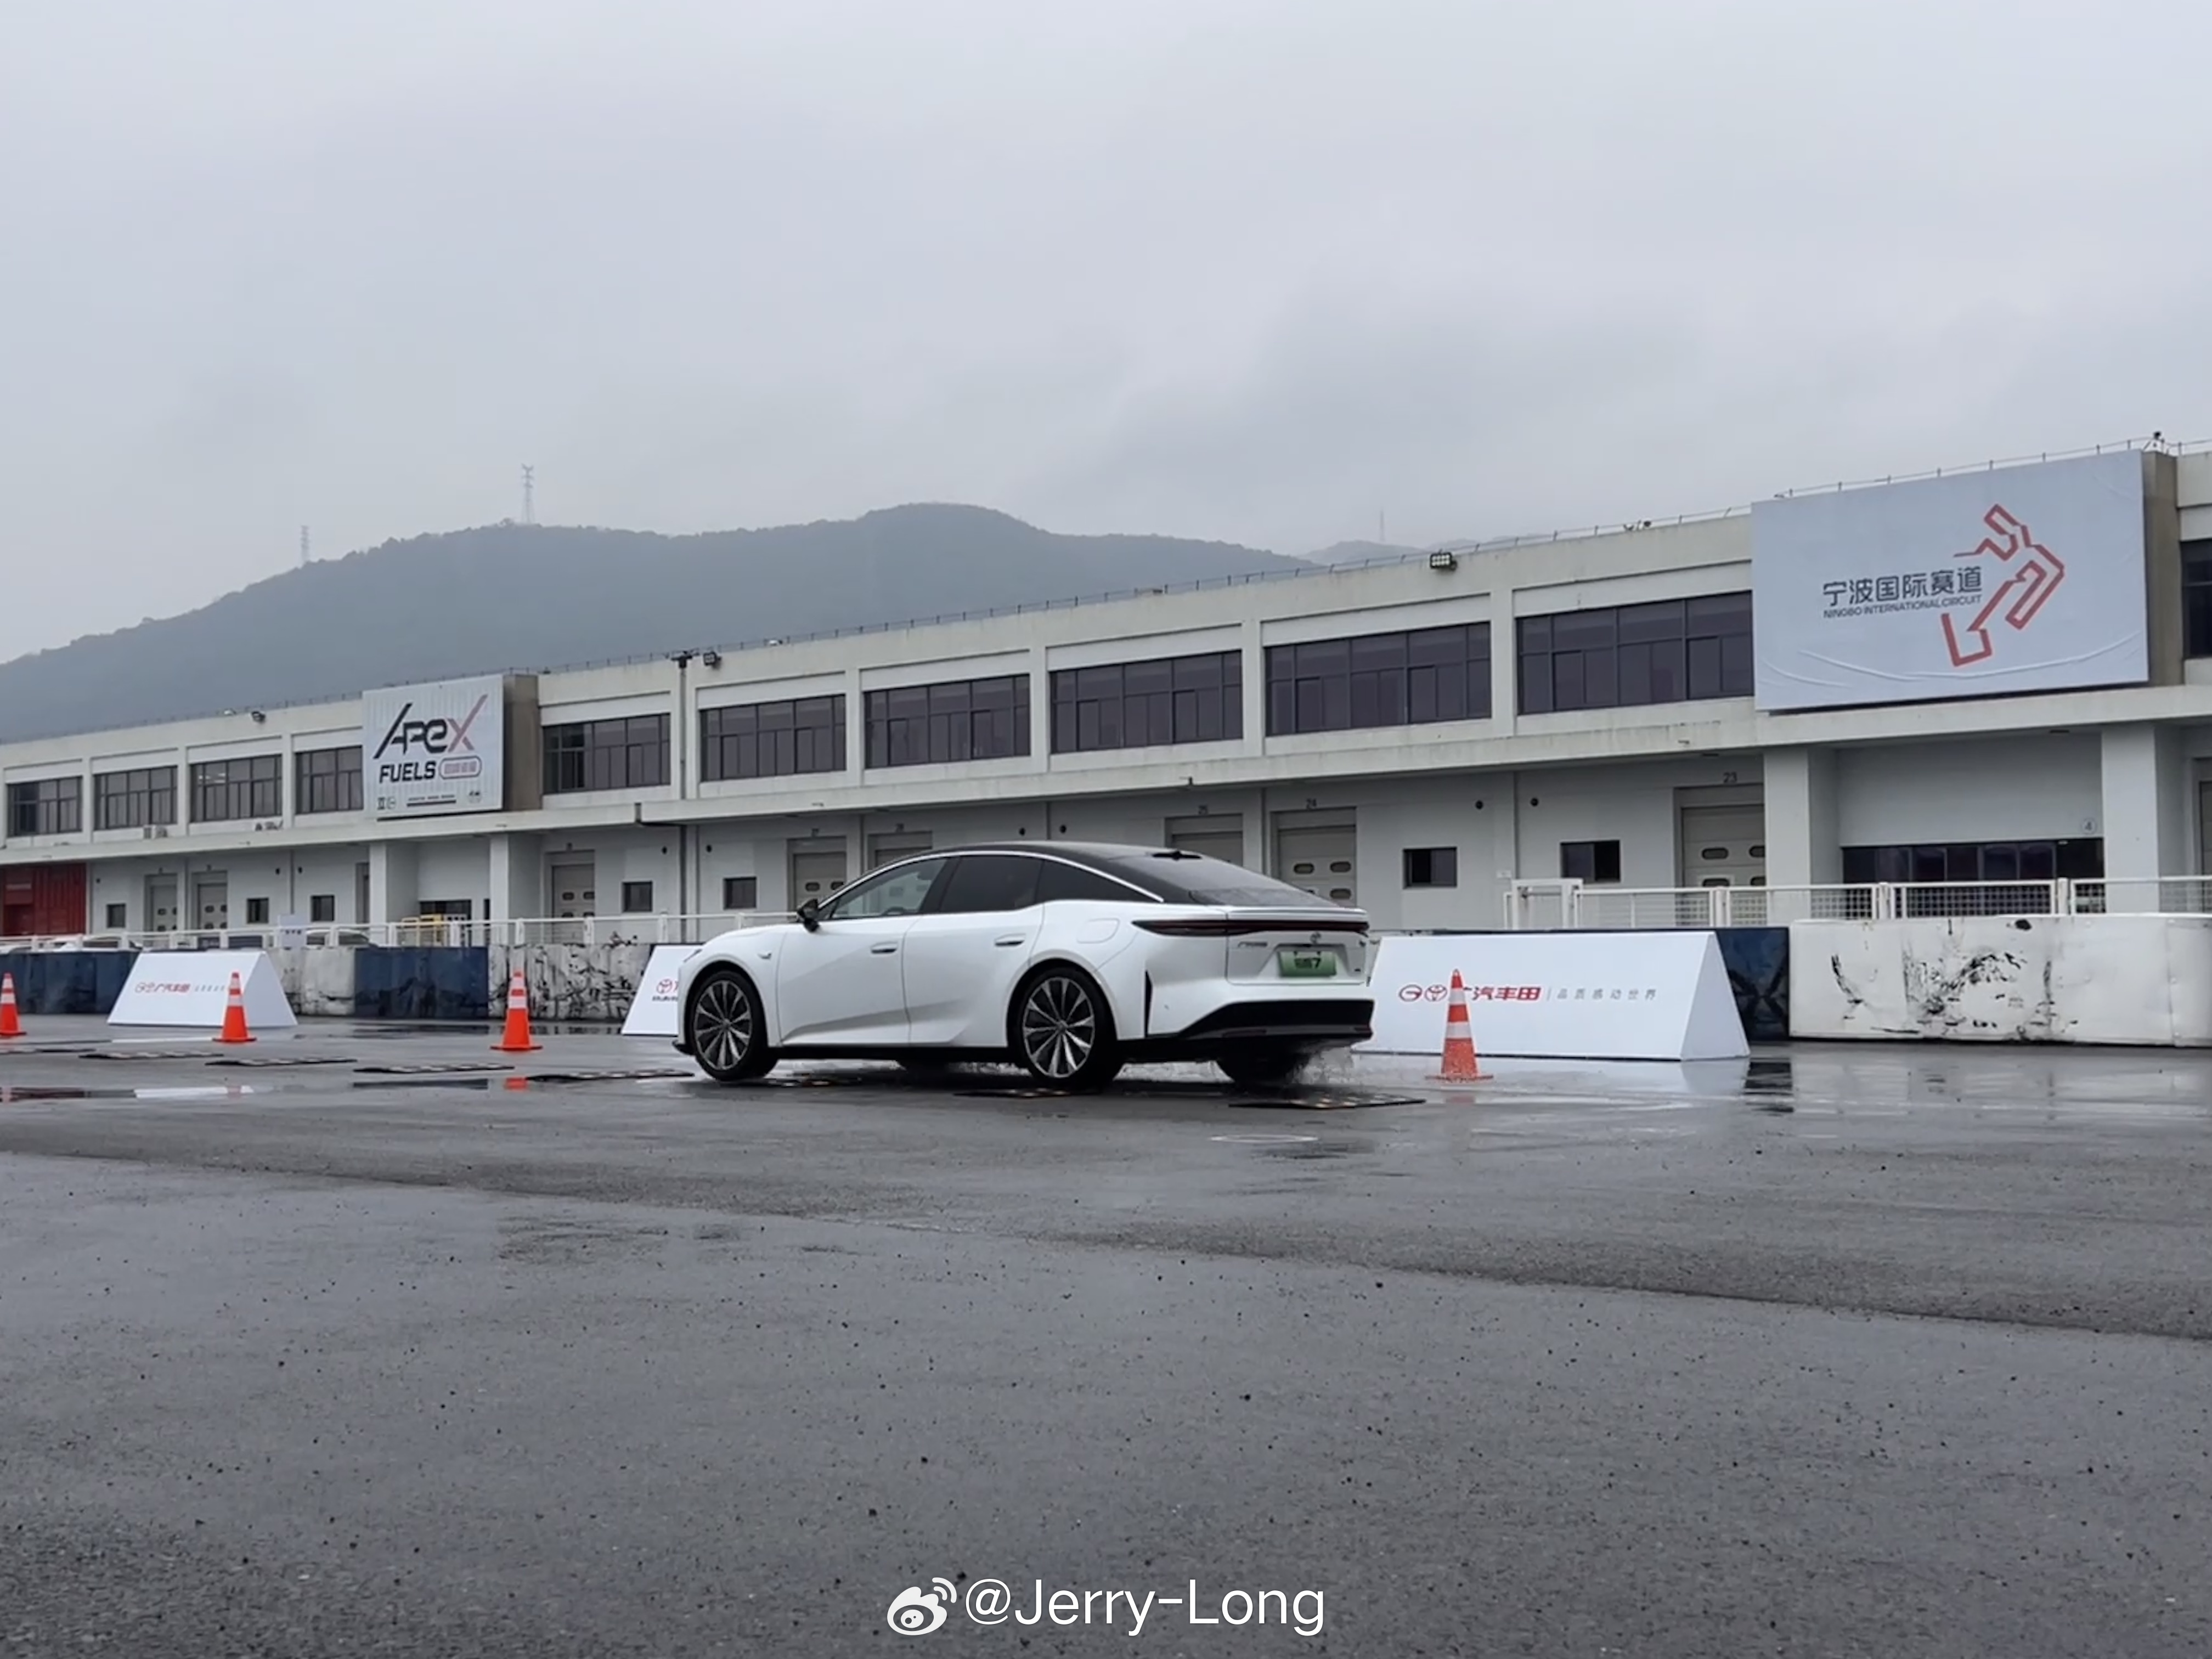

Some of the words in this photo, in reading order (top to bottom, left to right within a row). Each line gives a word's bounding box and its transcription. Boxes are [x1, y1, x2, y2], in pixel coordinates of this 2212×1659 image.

[1823, 566, 1982, 607] 宁波国际赛道
[1865, 599, 1939, 614] INTERNATIONAL
[1942, 595, 1982, 607] CIRCUIT
[379, 760, 437, 784] FUELS
